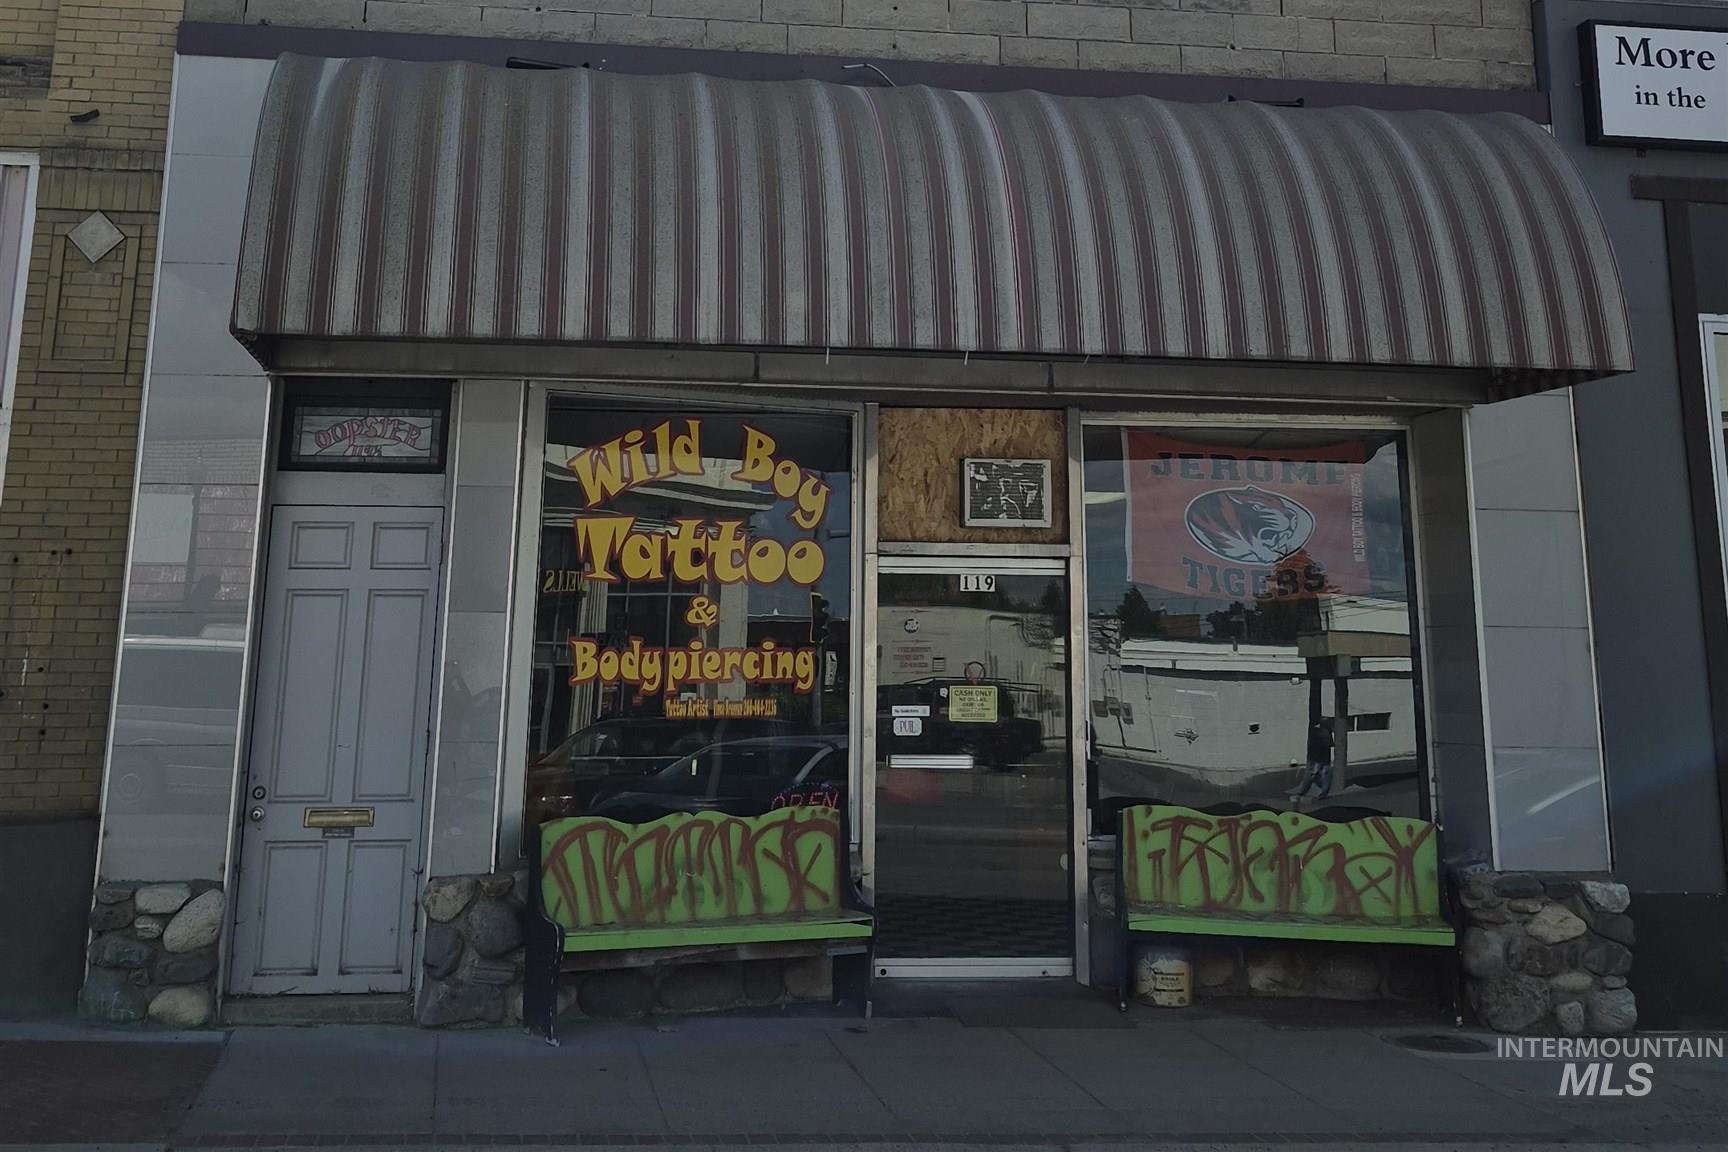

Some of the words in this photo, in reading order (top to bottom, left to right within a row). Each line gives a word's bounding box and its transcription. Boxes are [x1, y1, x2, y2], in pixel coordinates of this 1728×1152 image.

[1615, 35, 1716, 71] More
[1634, 84, 1660, 106] in
[1667, 86, 1706, 109] the
[567, 416, 705, 509] Wild
[731, 422, 832, 532] Boy
[1150, 451, 1350, 485] JEROME
[573, 514, 827, 586] Tattoo
[962, 575, 995, 591] 119
[1182, 556, 1328, 600] TIGERS
[685, 594, 720, 631] &
[568, 637, 816, 696] Bodypiercing
